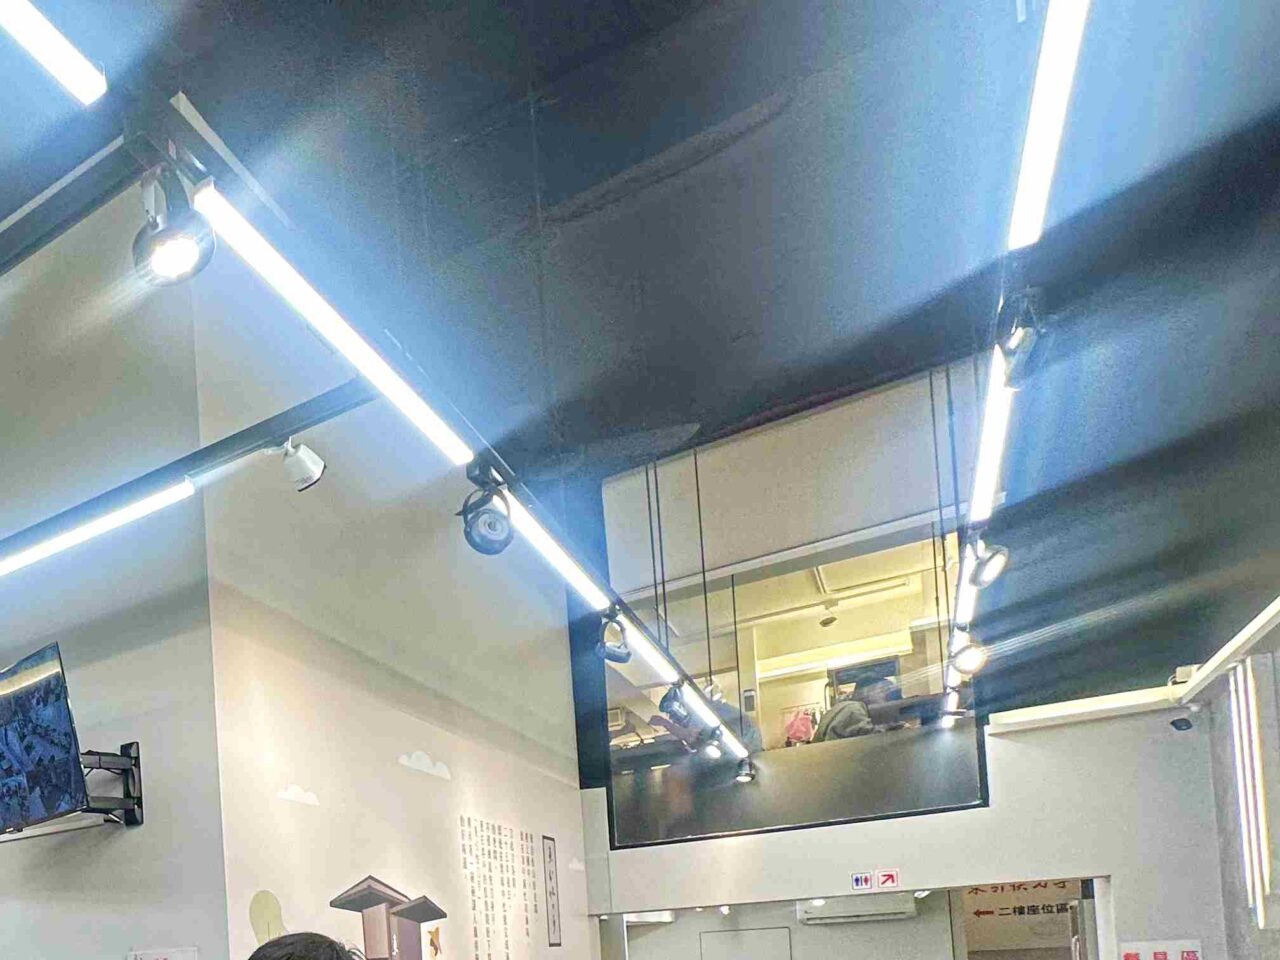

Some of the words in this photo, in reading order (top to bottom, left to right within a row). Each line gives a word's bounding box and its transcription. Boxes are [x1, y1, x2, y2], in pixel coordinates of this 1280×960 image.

[998, 902, 1069, 917] 二樓座位區
